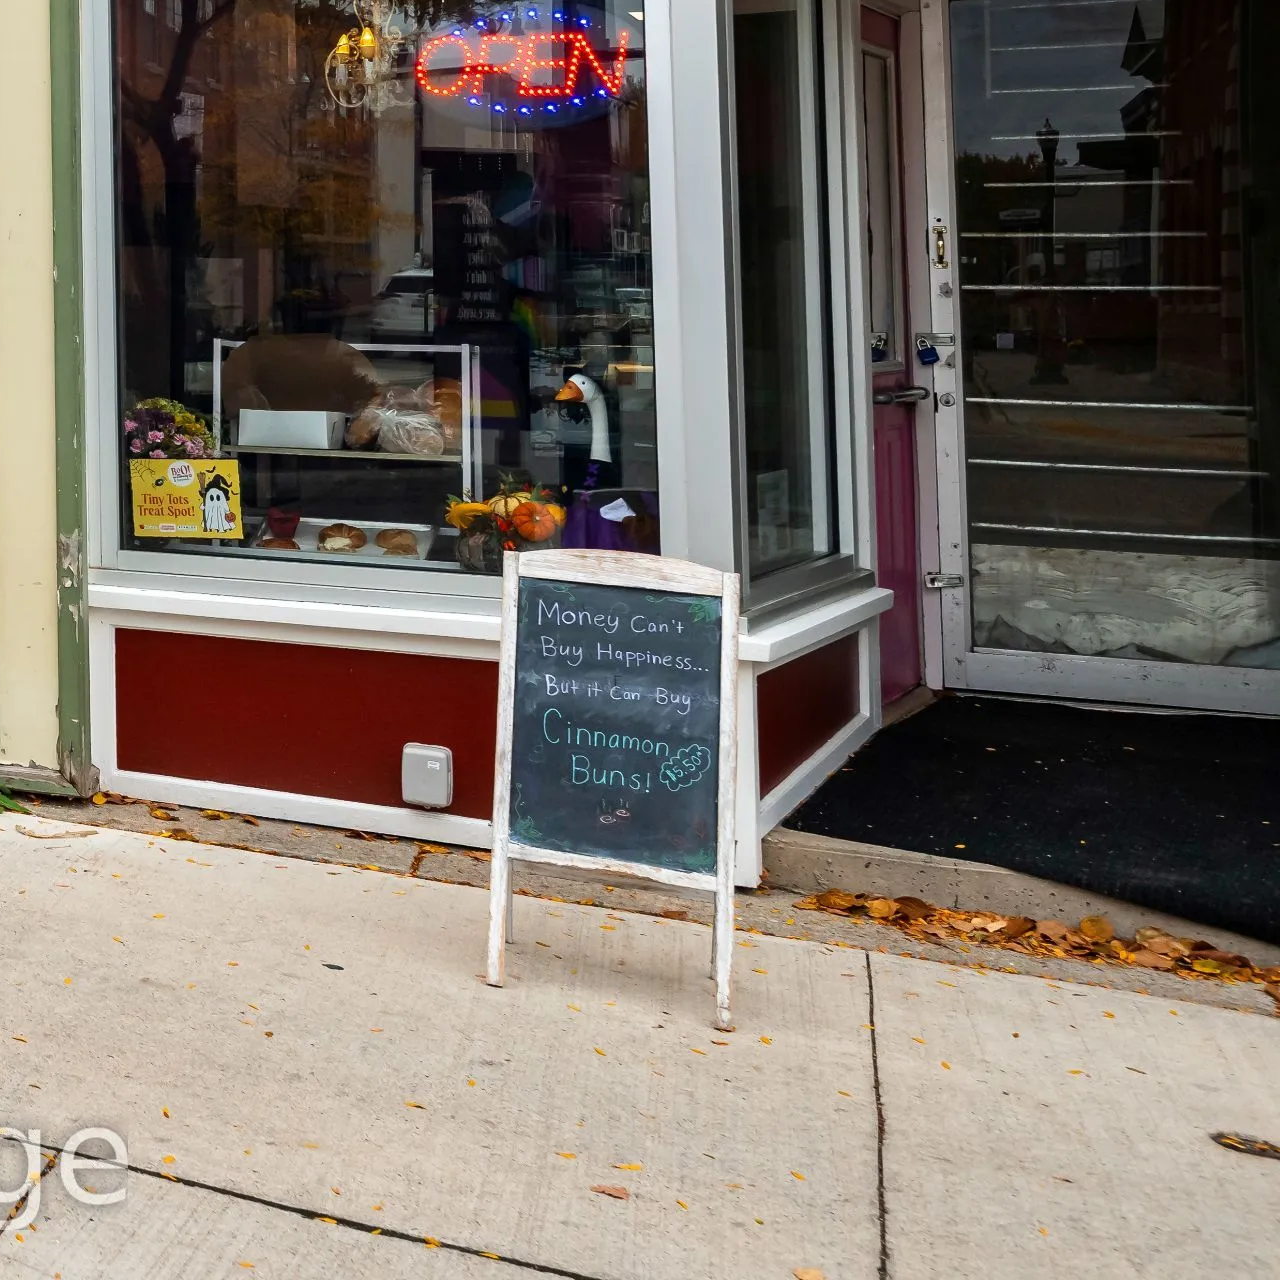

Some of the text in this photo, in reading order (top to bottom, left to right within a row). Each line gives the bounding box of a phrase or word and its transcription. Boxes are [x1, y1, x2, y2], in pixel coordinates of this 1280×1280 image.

[414, 28, 629, 97] OPEN
[137, 505, 195, 518] Treat Spot!
[141, 494, 189, 506] Tiny Tots
[537, 599, 684, 634] Money Can't
[541, 636, 584, 666] Buy
[545, 674, 691, 715] But it Can Buy
[543, 708, 669, 757] Cinnamon
[571, 754, 651, 793] Buns!
